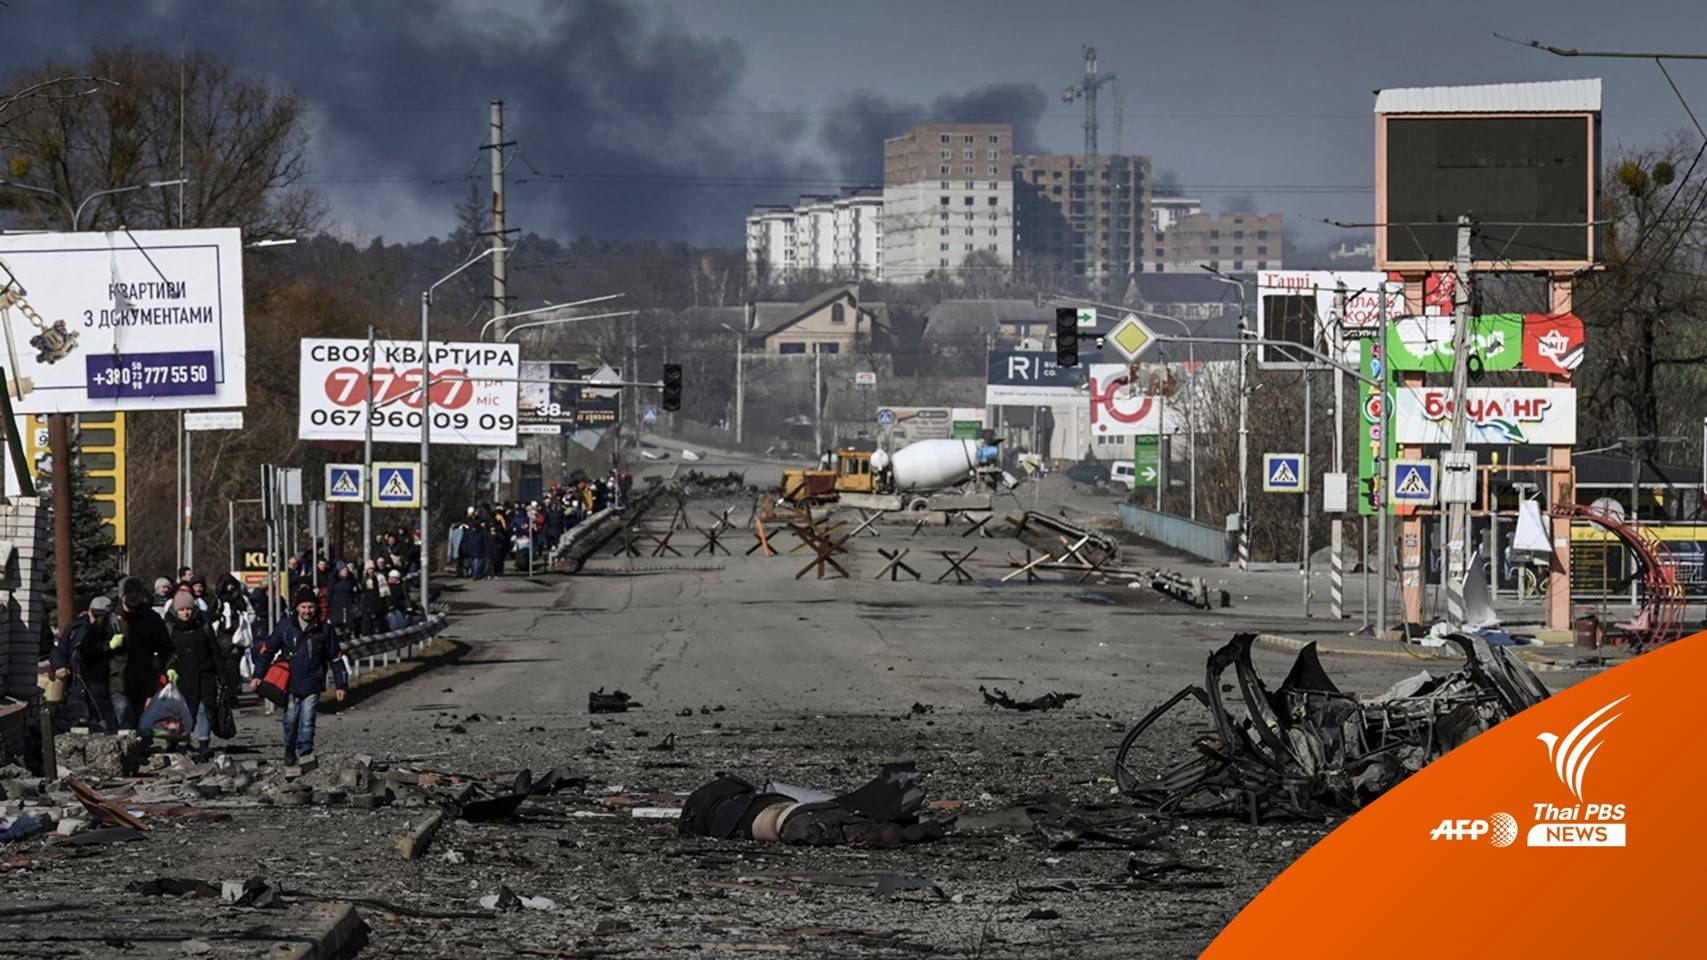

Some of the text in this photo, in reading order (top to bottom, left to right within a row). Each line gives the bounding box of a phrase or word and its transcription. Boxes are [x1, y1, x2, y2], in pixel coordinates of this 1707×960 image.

[84, 306, 213, 328] З ДОКУМЕНТАМИ
[311, 345, 514, 366] СВОЯ КВАРТИРА
[144, 366, 169, 384] 777
[171, 365, 188, 383] 55
[190, 365, 207, 383] 50
[335, 373, 463, 406] 7777
[477, 394, 500, 406] міс
[311, 409, 514, 431] 067 960 09 09
